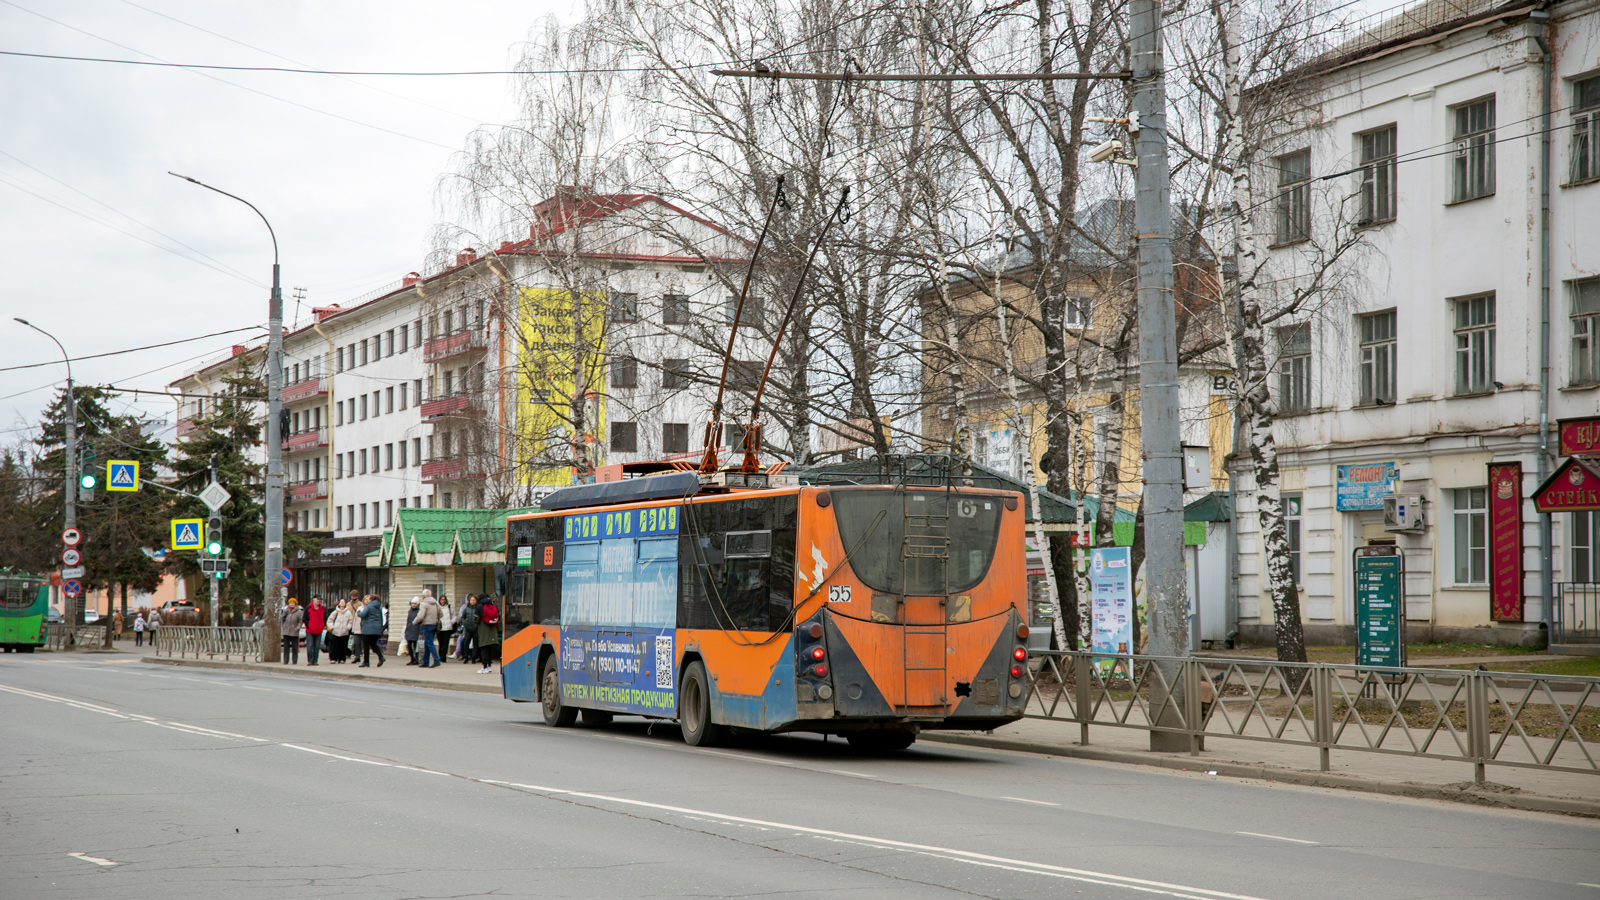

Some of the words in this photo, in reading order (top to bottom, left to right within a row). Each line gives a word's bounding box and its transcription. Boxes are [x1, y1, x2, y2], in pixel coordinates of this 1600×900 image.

[532, 305, 574, 317] Закаж
[533, 325, 570, 334] такси
[1349, 466, 1386, 482] РЕМОНТ
[1364, 497, 1384, 506] ТЕЛЕФО
[1546, 488, 1600, 505] СТЕЙК
[962, 500, 972, 515] 6
[545, 549, 552, 562] 55
[601, 545, 634, 573] МАГАЗИН
[830, 585, 851, 602] 55
[592, 640, 607, 652] Глеба
[607, 641, 635, 655] Успенского,
[636, 643, 641, 655] д.
[642, 641, 647, 654] 11
[590, 657, 597, 670] +7
[599, 657, 614, 674] (930)
[615, 657, 640, 674] 110-11-47
[563, 683, 589, 700] КРЕПЕЖ
[590, 686, 594, 700] И
[595, 686, 631, 704] МЕТИЗНАЯ
[631, 689, 674, 710] ПРОДУКЦИЯ
